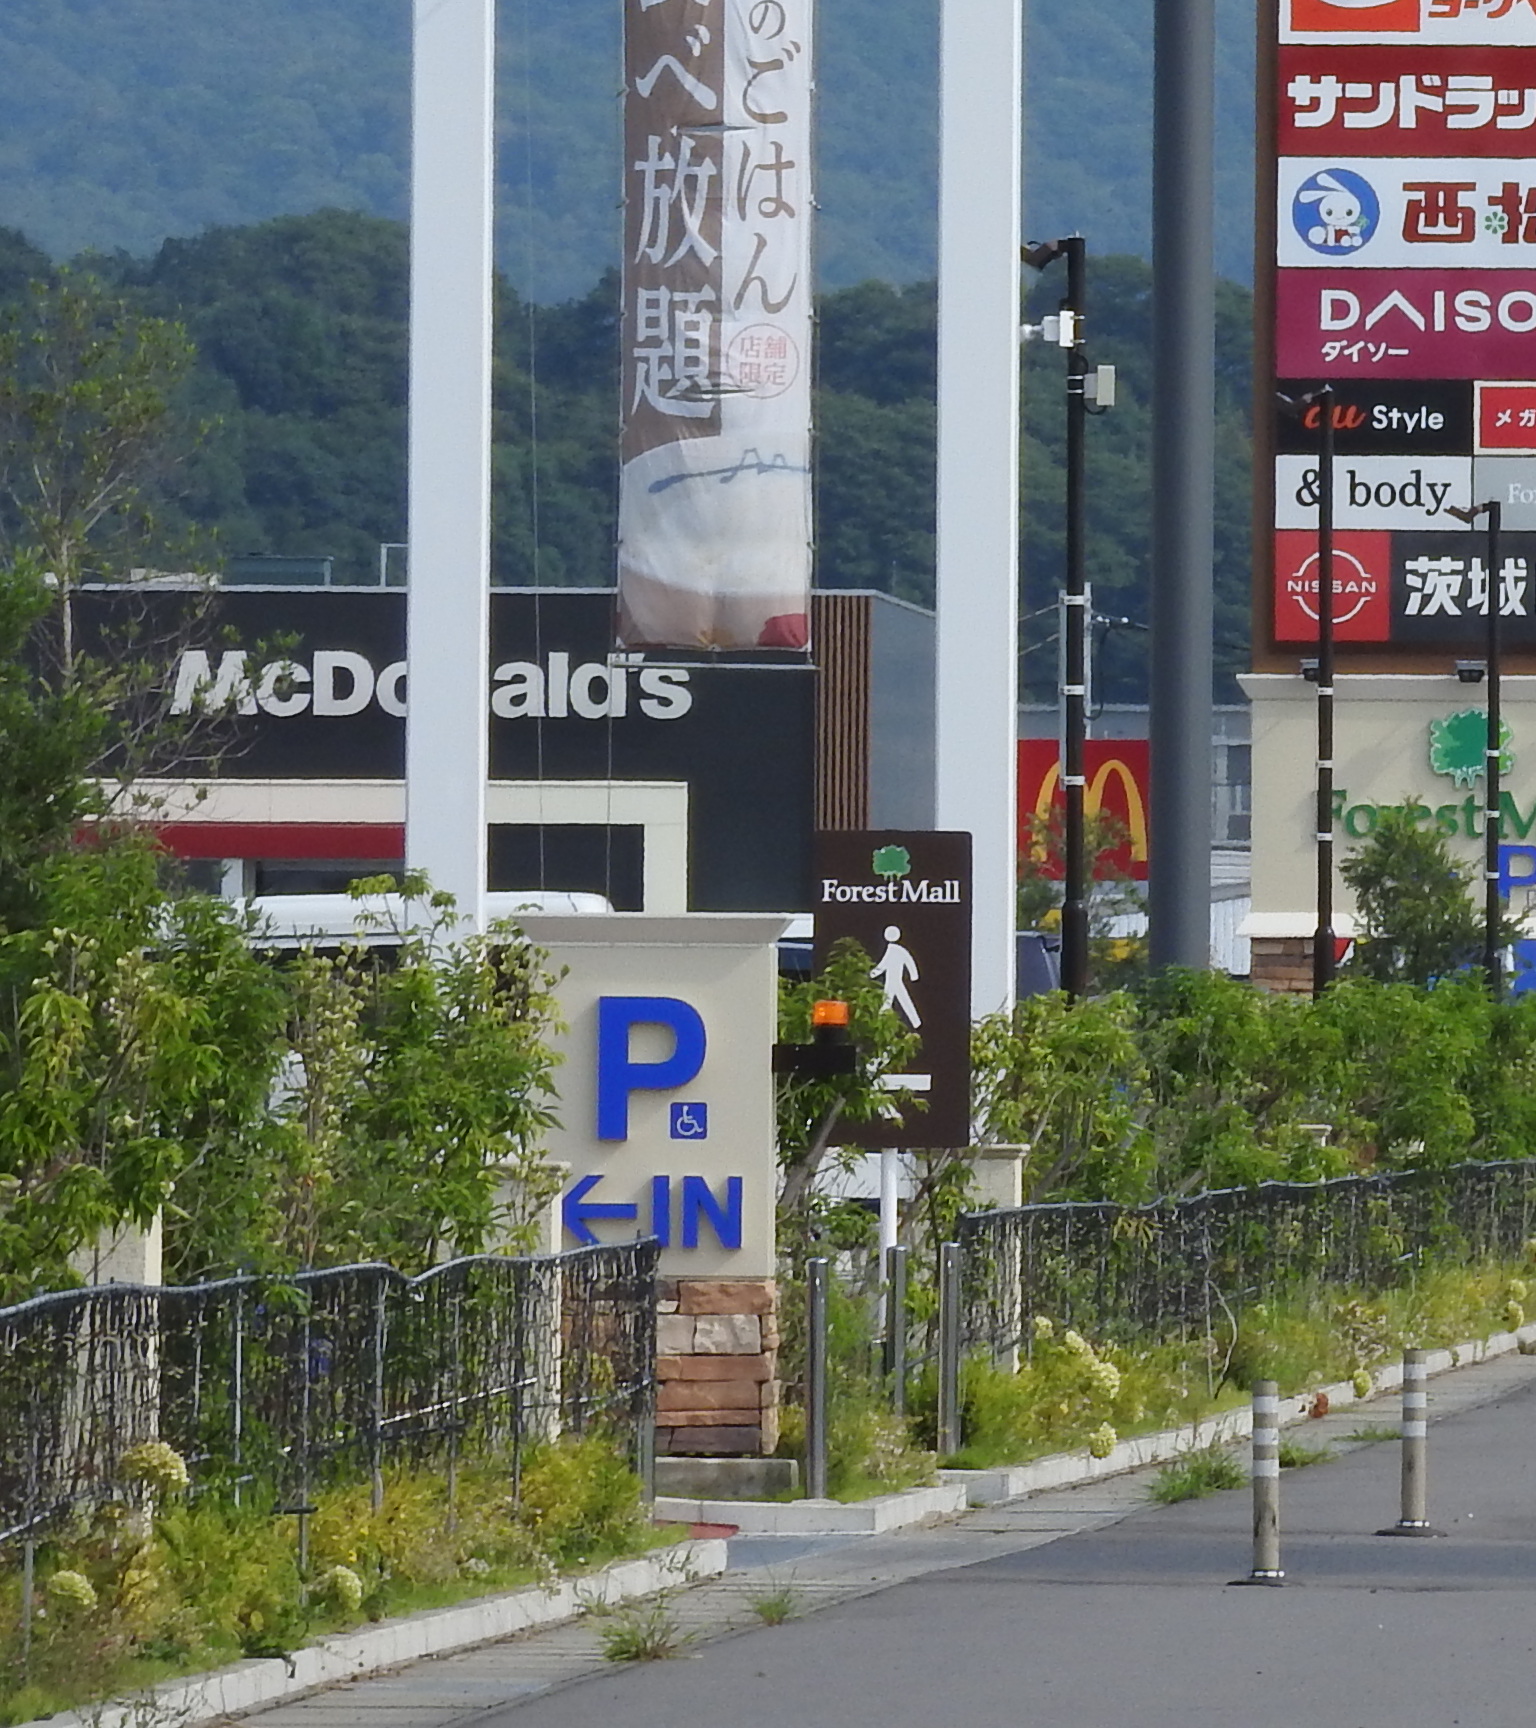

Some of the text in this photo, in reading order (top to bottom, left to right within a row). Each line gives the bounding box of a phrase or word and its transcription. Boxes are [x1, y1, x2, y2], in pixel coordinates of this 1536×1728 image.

[1321, 341, 1410, 363] ダイソー
[1372, 403, 1445, 434] Style
[1295, 468, 1452, 516] & body
[169, 649, 694, 719] McDoald's
[821, 878, 961, 904] Forest Mall
[596, 995, 708, 1142] P
[652, 1175, 743, 1250] IN
